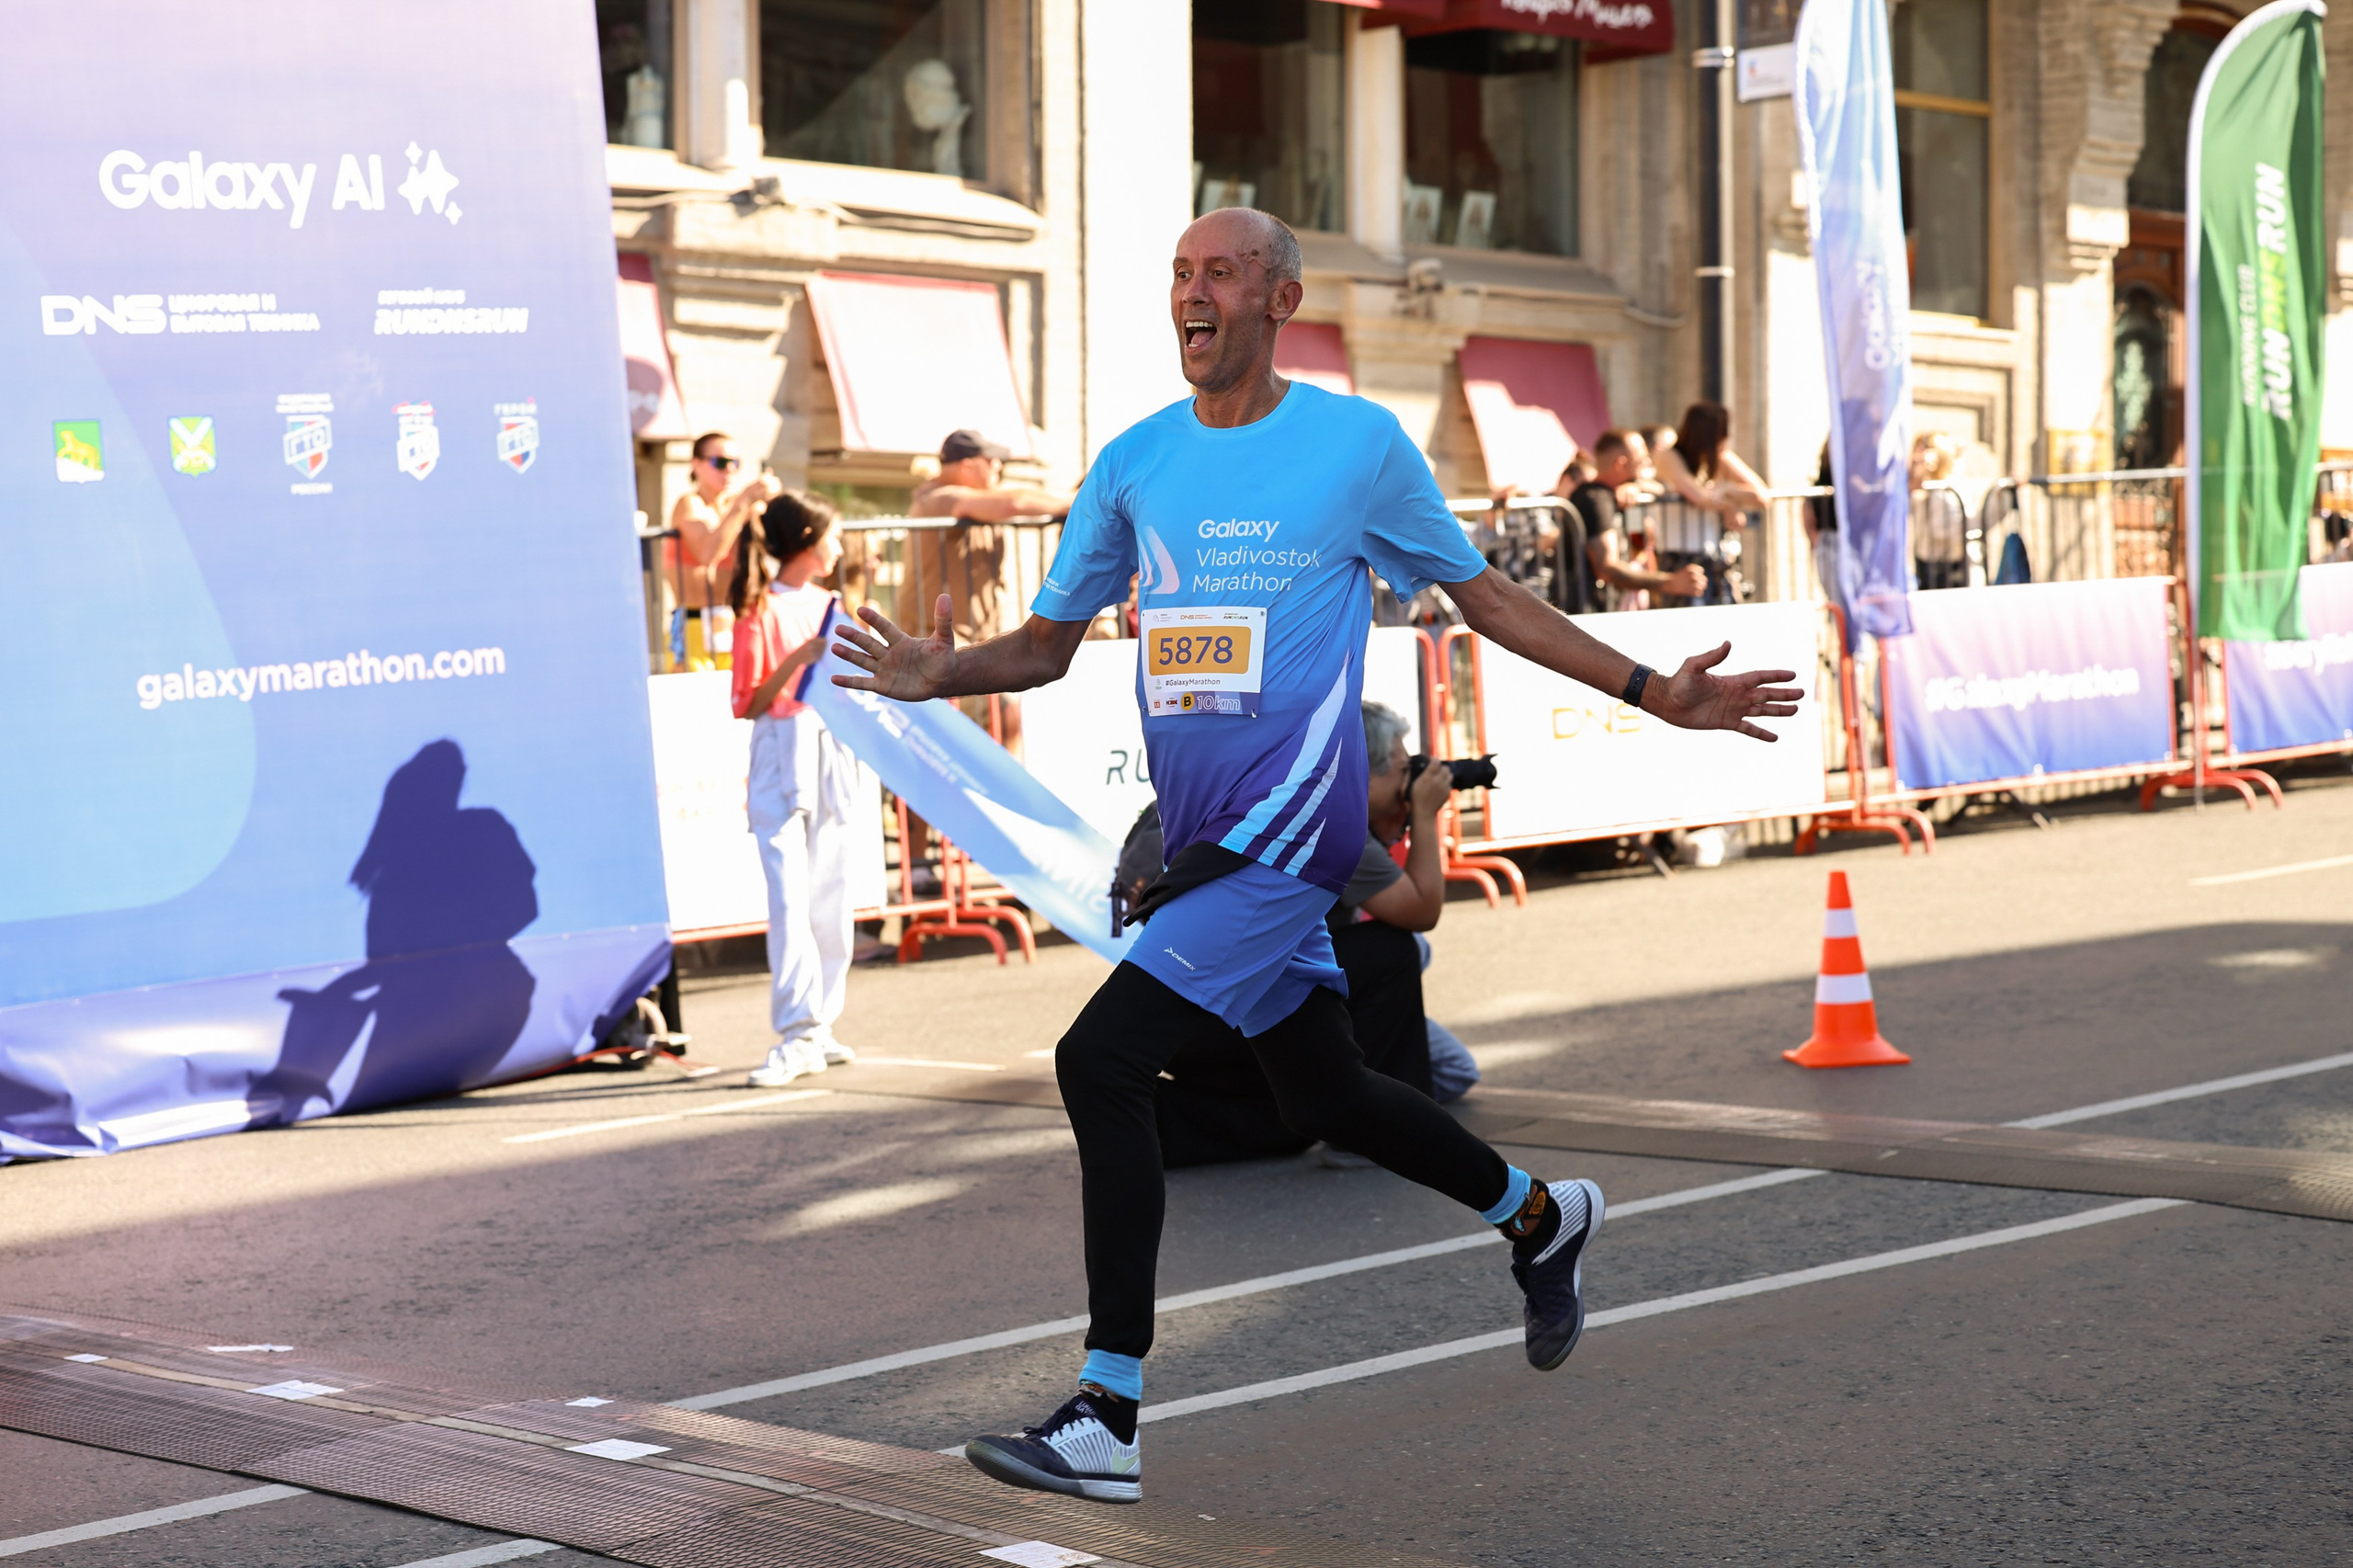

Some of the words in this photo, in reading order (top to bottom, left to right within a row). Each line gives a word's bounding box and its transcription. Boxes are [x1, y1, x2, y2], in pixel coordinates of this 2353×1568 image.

[98, 149, 317, 229] Galaxy
[332, 153, 385, 210] AI
[40, 294, 167, 335] DNS
[1198, 518, 1280, 543] Galaxy
[1196, 545, 1323, 568] Vladivostok
[1192, 573, 1292, 593] Marathon
[1158, 635, 1233, 665] 5878
[136, 646, 506, 710] galaxymarathon.com
[1165, 678, 1221, 687] #GalaxyMarathon
[1183, 696, 1192, 708] B
[1197, 695, 1241, 710] 10km
[1552, 703, 1643, 739] DNS
[1171, 952, 1196, 971] DEMIX
